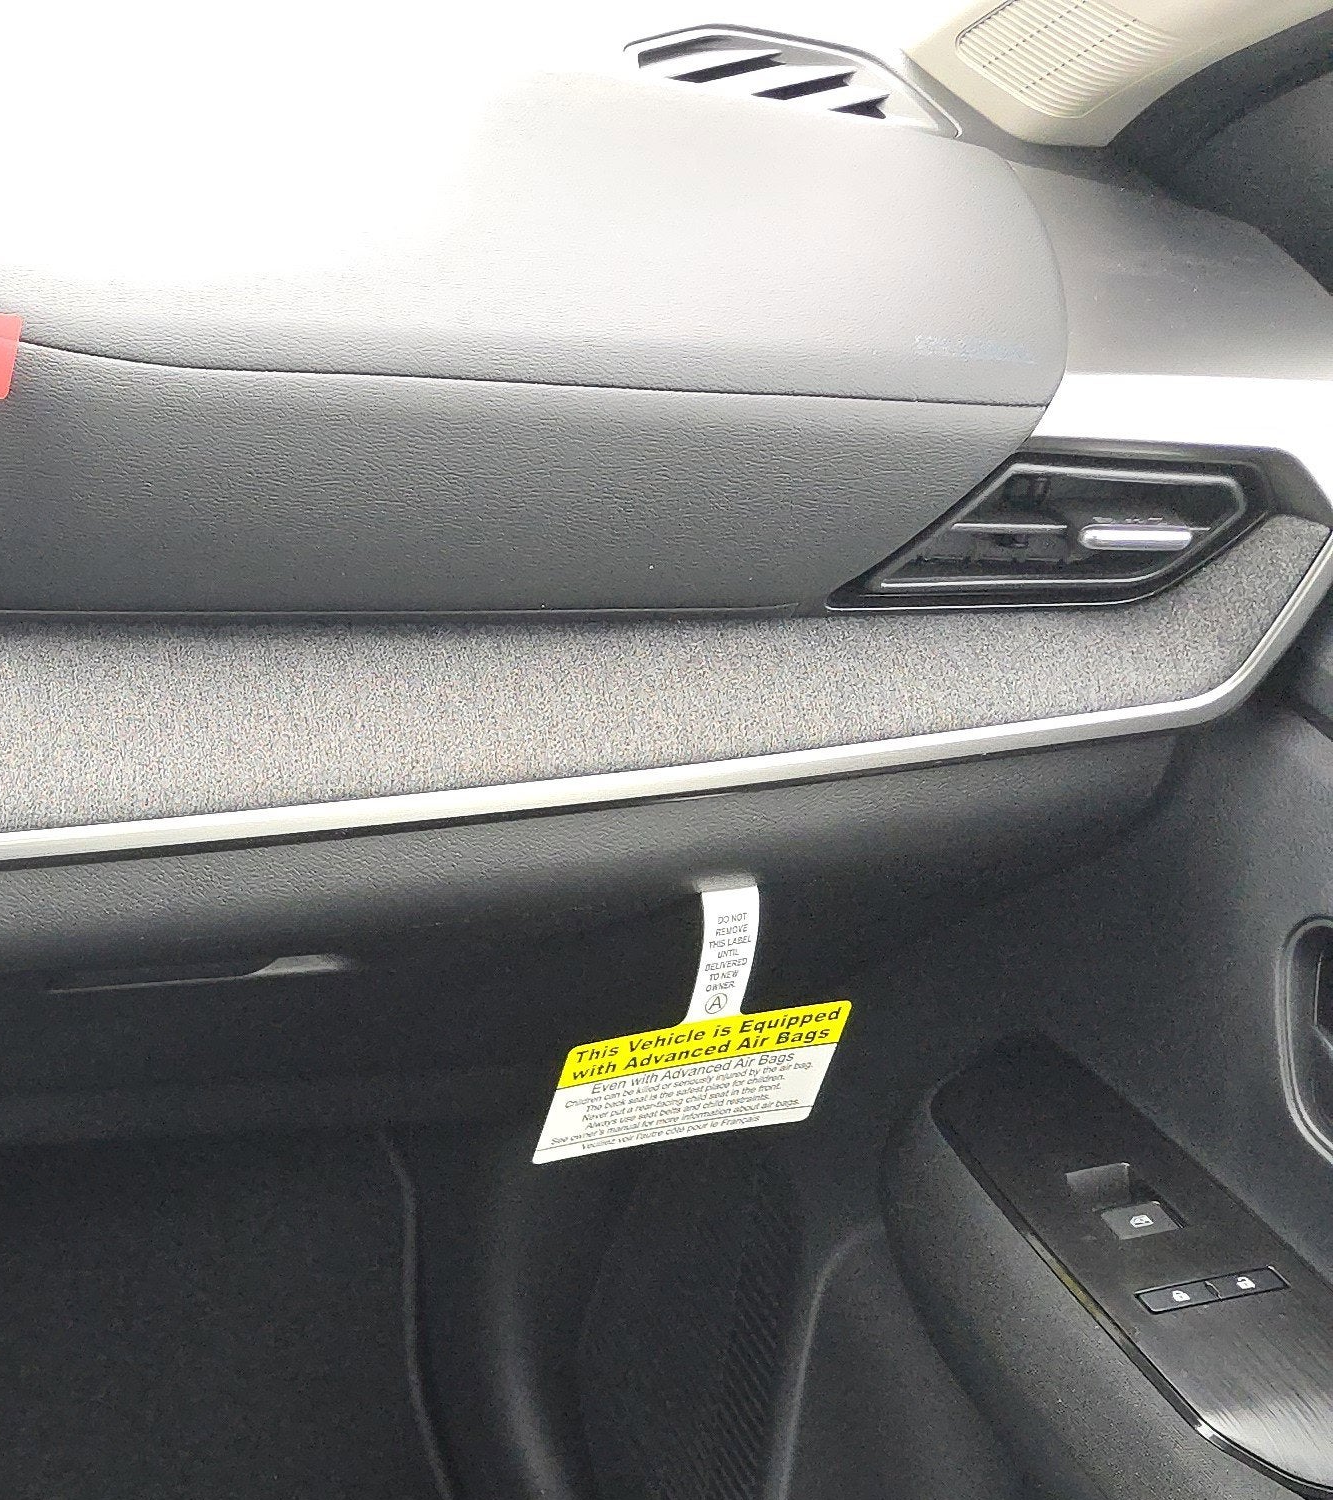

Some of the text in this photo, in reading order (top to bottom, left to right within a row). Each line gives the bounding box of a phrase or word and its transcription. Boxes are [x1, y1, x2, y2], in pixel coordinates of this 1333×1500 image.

[732, 913, 748, 923] NOT
[709, 936, 751, 949] THIS LABEL
[573, 1028, 831, 1080] with Advanced Air Bags
[576, 1006, 842, 1064] This Vehicle is Equipped
[591, 1053, 795, 1095] Even with Advanced Air Bags
